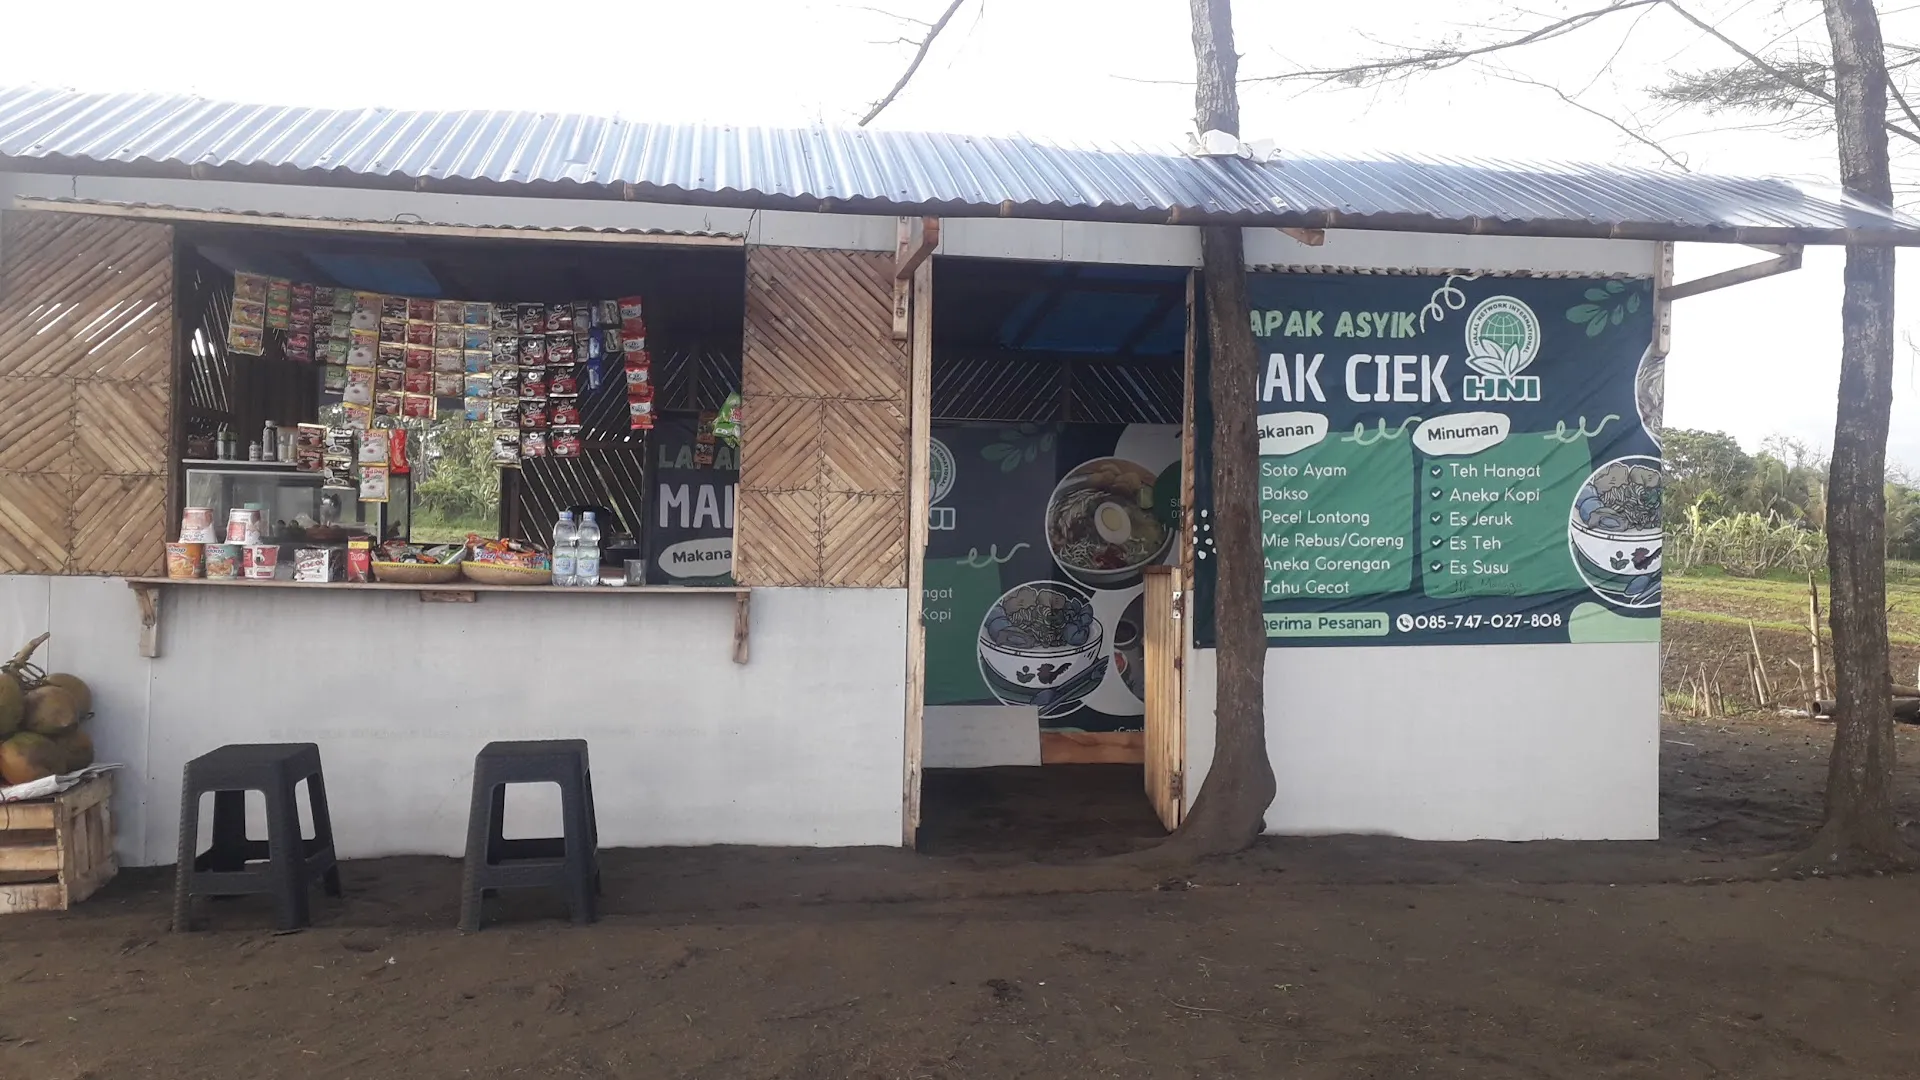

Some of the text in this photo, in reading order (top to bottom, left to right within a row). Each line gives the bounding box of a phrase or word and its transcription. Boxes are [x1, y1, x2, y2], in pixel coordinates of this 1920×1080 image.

[1250, 310, 1417, 339] APAK ASYIK
[1473, 302, 1534, 354] HALAL NETWORK INTERNATIONAL
[1255, 353, 1451, 403] AK CIEK
[1463, 375, 1541, 401] HNI
[1258, 424, 1315, 440] akanan
[1427, 424, 1499, 441] Minuman
[1262, 463, 1347, 480] Soto Ayam
[1450, 463, 1541, 480] Teh Hangat
[1262, 486, 1309, 500] Bakso
[1450, 487, 1540, 504] Aneka Kopi
[1262, 509, 1370, 527] Pecel Lontong
[1450, 511, 1513, 526] Es Jeruk
[1262, 532, 1404, 549] Mie Rebus/Goreng
[1450, 535, 1502, 550] Es Teh
[672, 549, 732, 564] Makana
[1263, 556, 1391, 573] Aneka Gorengan
[1450, 560, 1509, 574] Es Susu
[924, 587, 952, 602] ngat
[1263, 580, 1350, 594] Tahu Gecot
[1264, 616, 1382, 630] nerima Pesanan
[1415, 613, 1562, 629] 085-747-027-808
